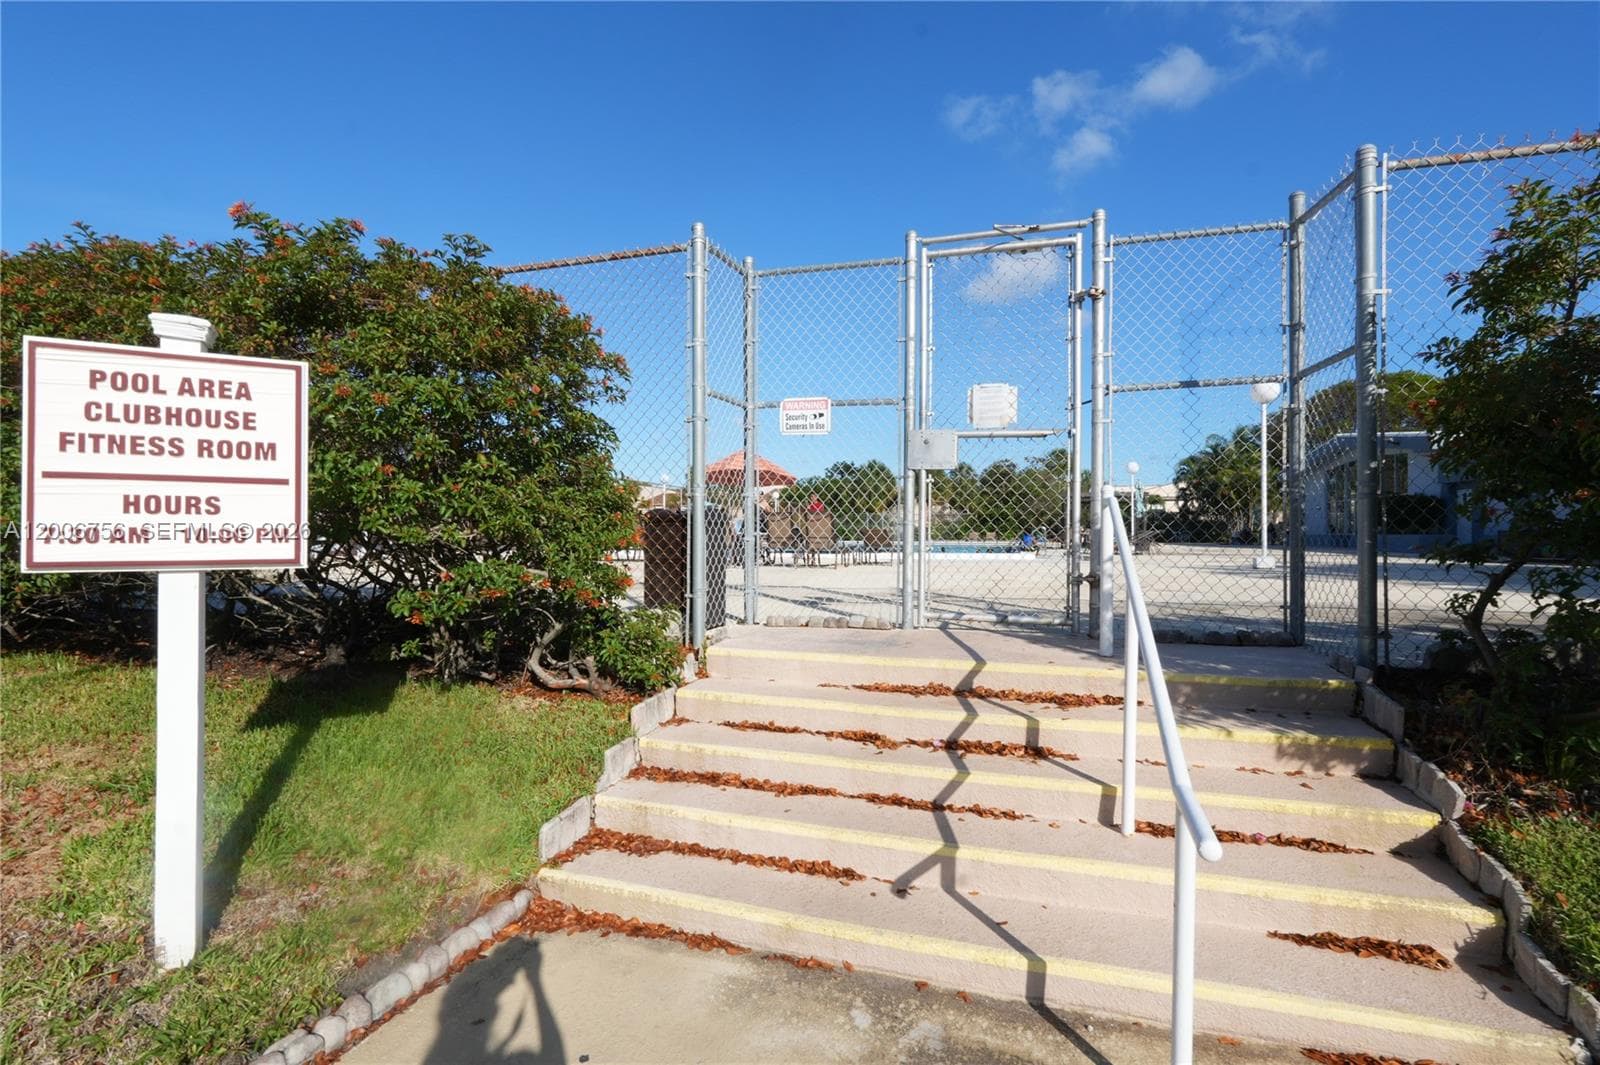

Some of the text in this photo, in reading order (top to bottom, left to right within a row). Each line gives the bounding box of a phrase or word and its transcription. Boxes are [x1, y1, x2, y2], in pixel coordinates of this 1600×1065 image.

[89, 369, 252, 401] POOL AREA
[84, 401, 257, 430] CLUBHOUSE
[785, 401, 826, 409] WARNING
[785, 413, 808, 421] Security
[59, 431, 277, 461] FITNESS ROOM
[122, 494, 221, 515] HOURS
[109, 527, 150, 544] AM
[256, 527, 289, 543] PM
